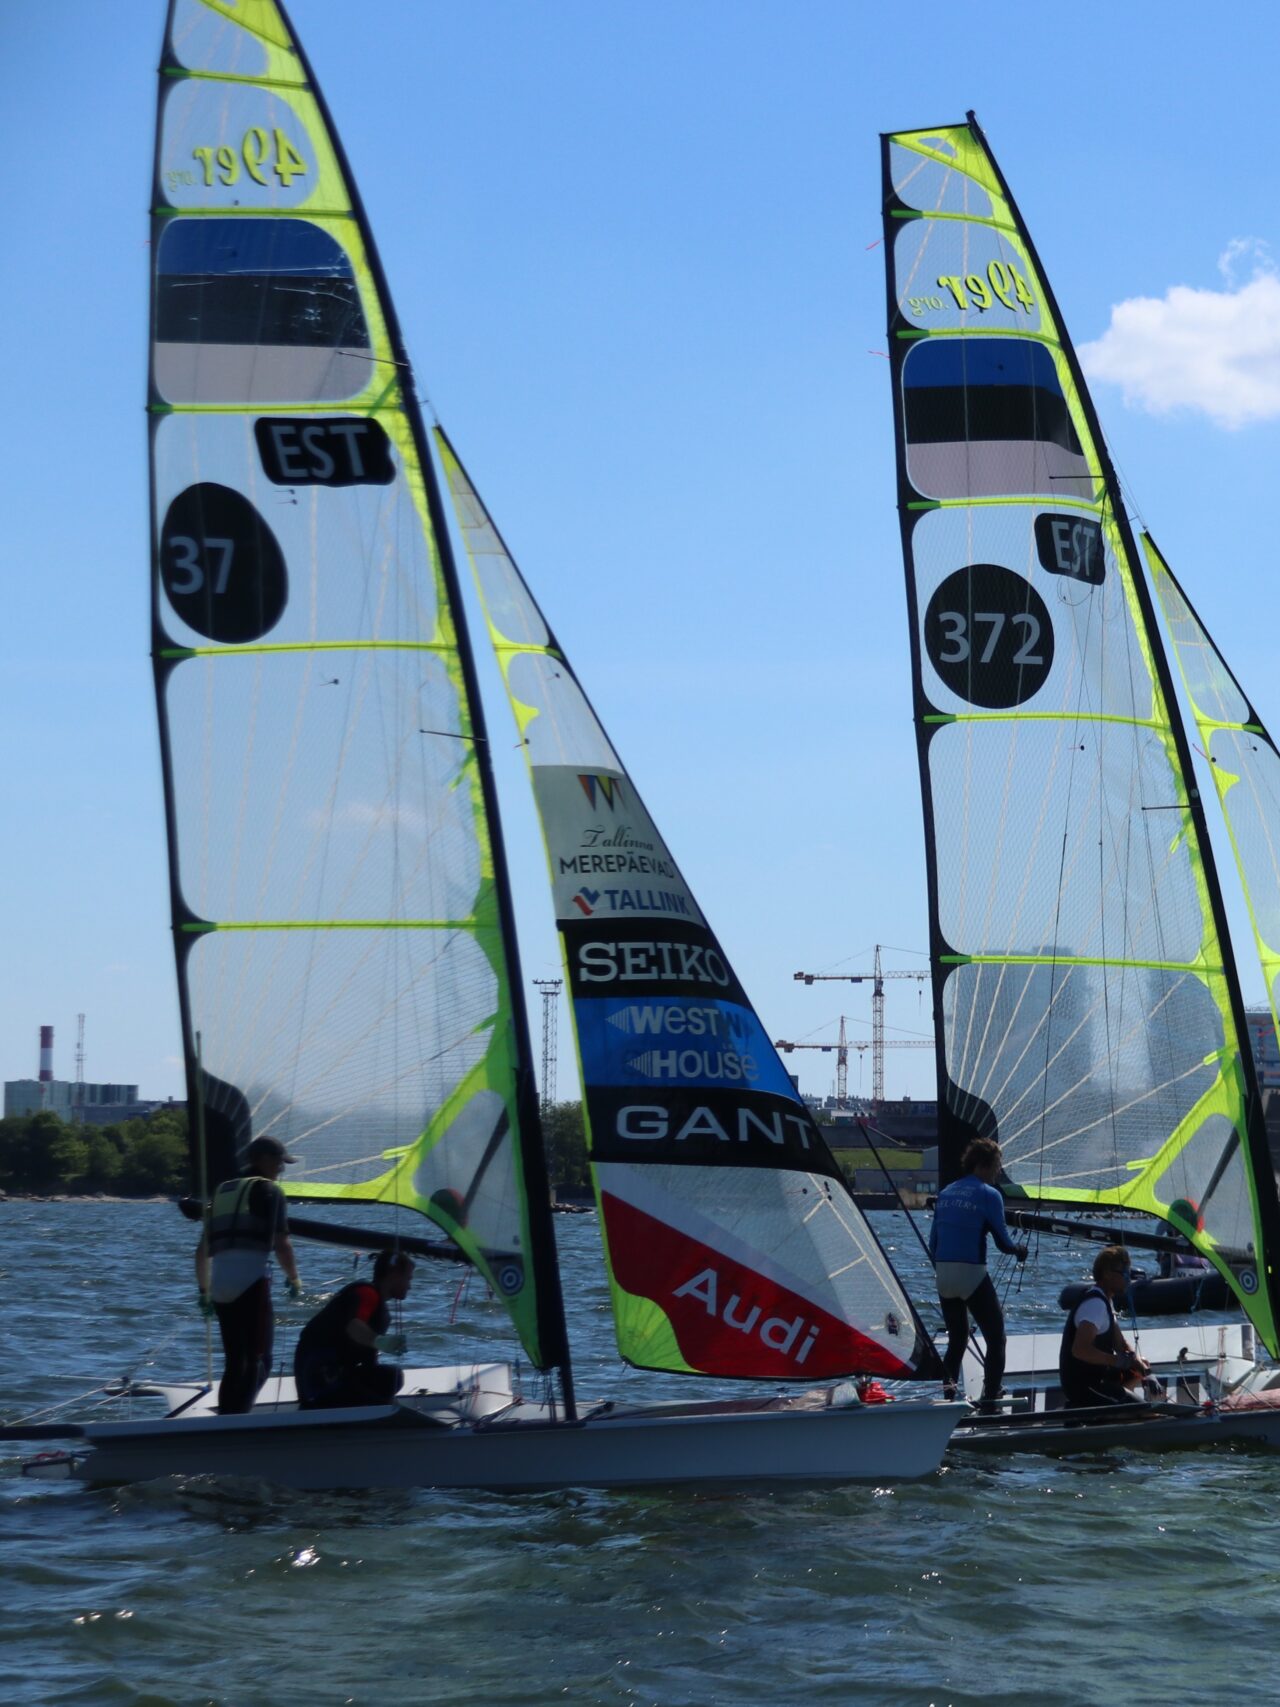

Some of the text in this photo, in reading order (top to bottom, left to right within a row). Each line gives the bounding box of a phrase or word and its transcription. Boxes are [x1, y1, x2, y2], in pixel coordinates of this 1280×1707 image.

[270, 424, 368, 479] EST
[168, 535, 235, 594] 37
[1051, 521, 1096, 577] EST
[938, 611, 1044, 665] 372
[580, 824, 655, 849] Tallinna
[559, 851, 676, 880] MEREPÄEVAD
[604, 888, 690, 916] TALLINK
[577, 941, 730, 988] SEIKO
[616, 1104, 812, 1150] GANT
[671, 1267, 822, 1365] Audi
